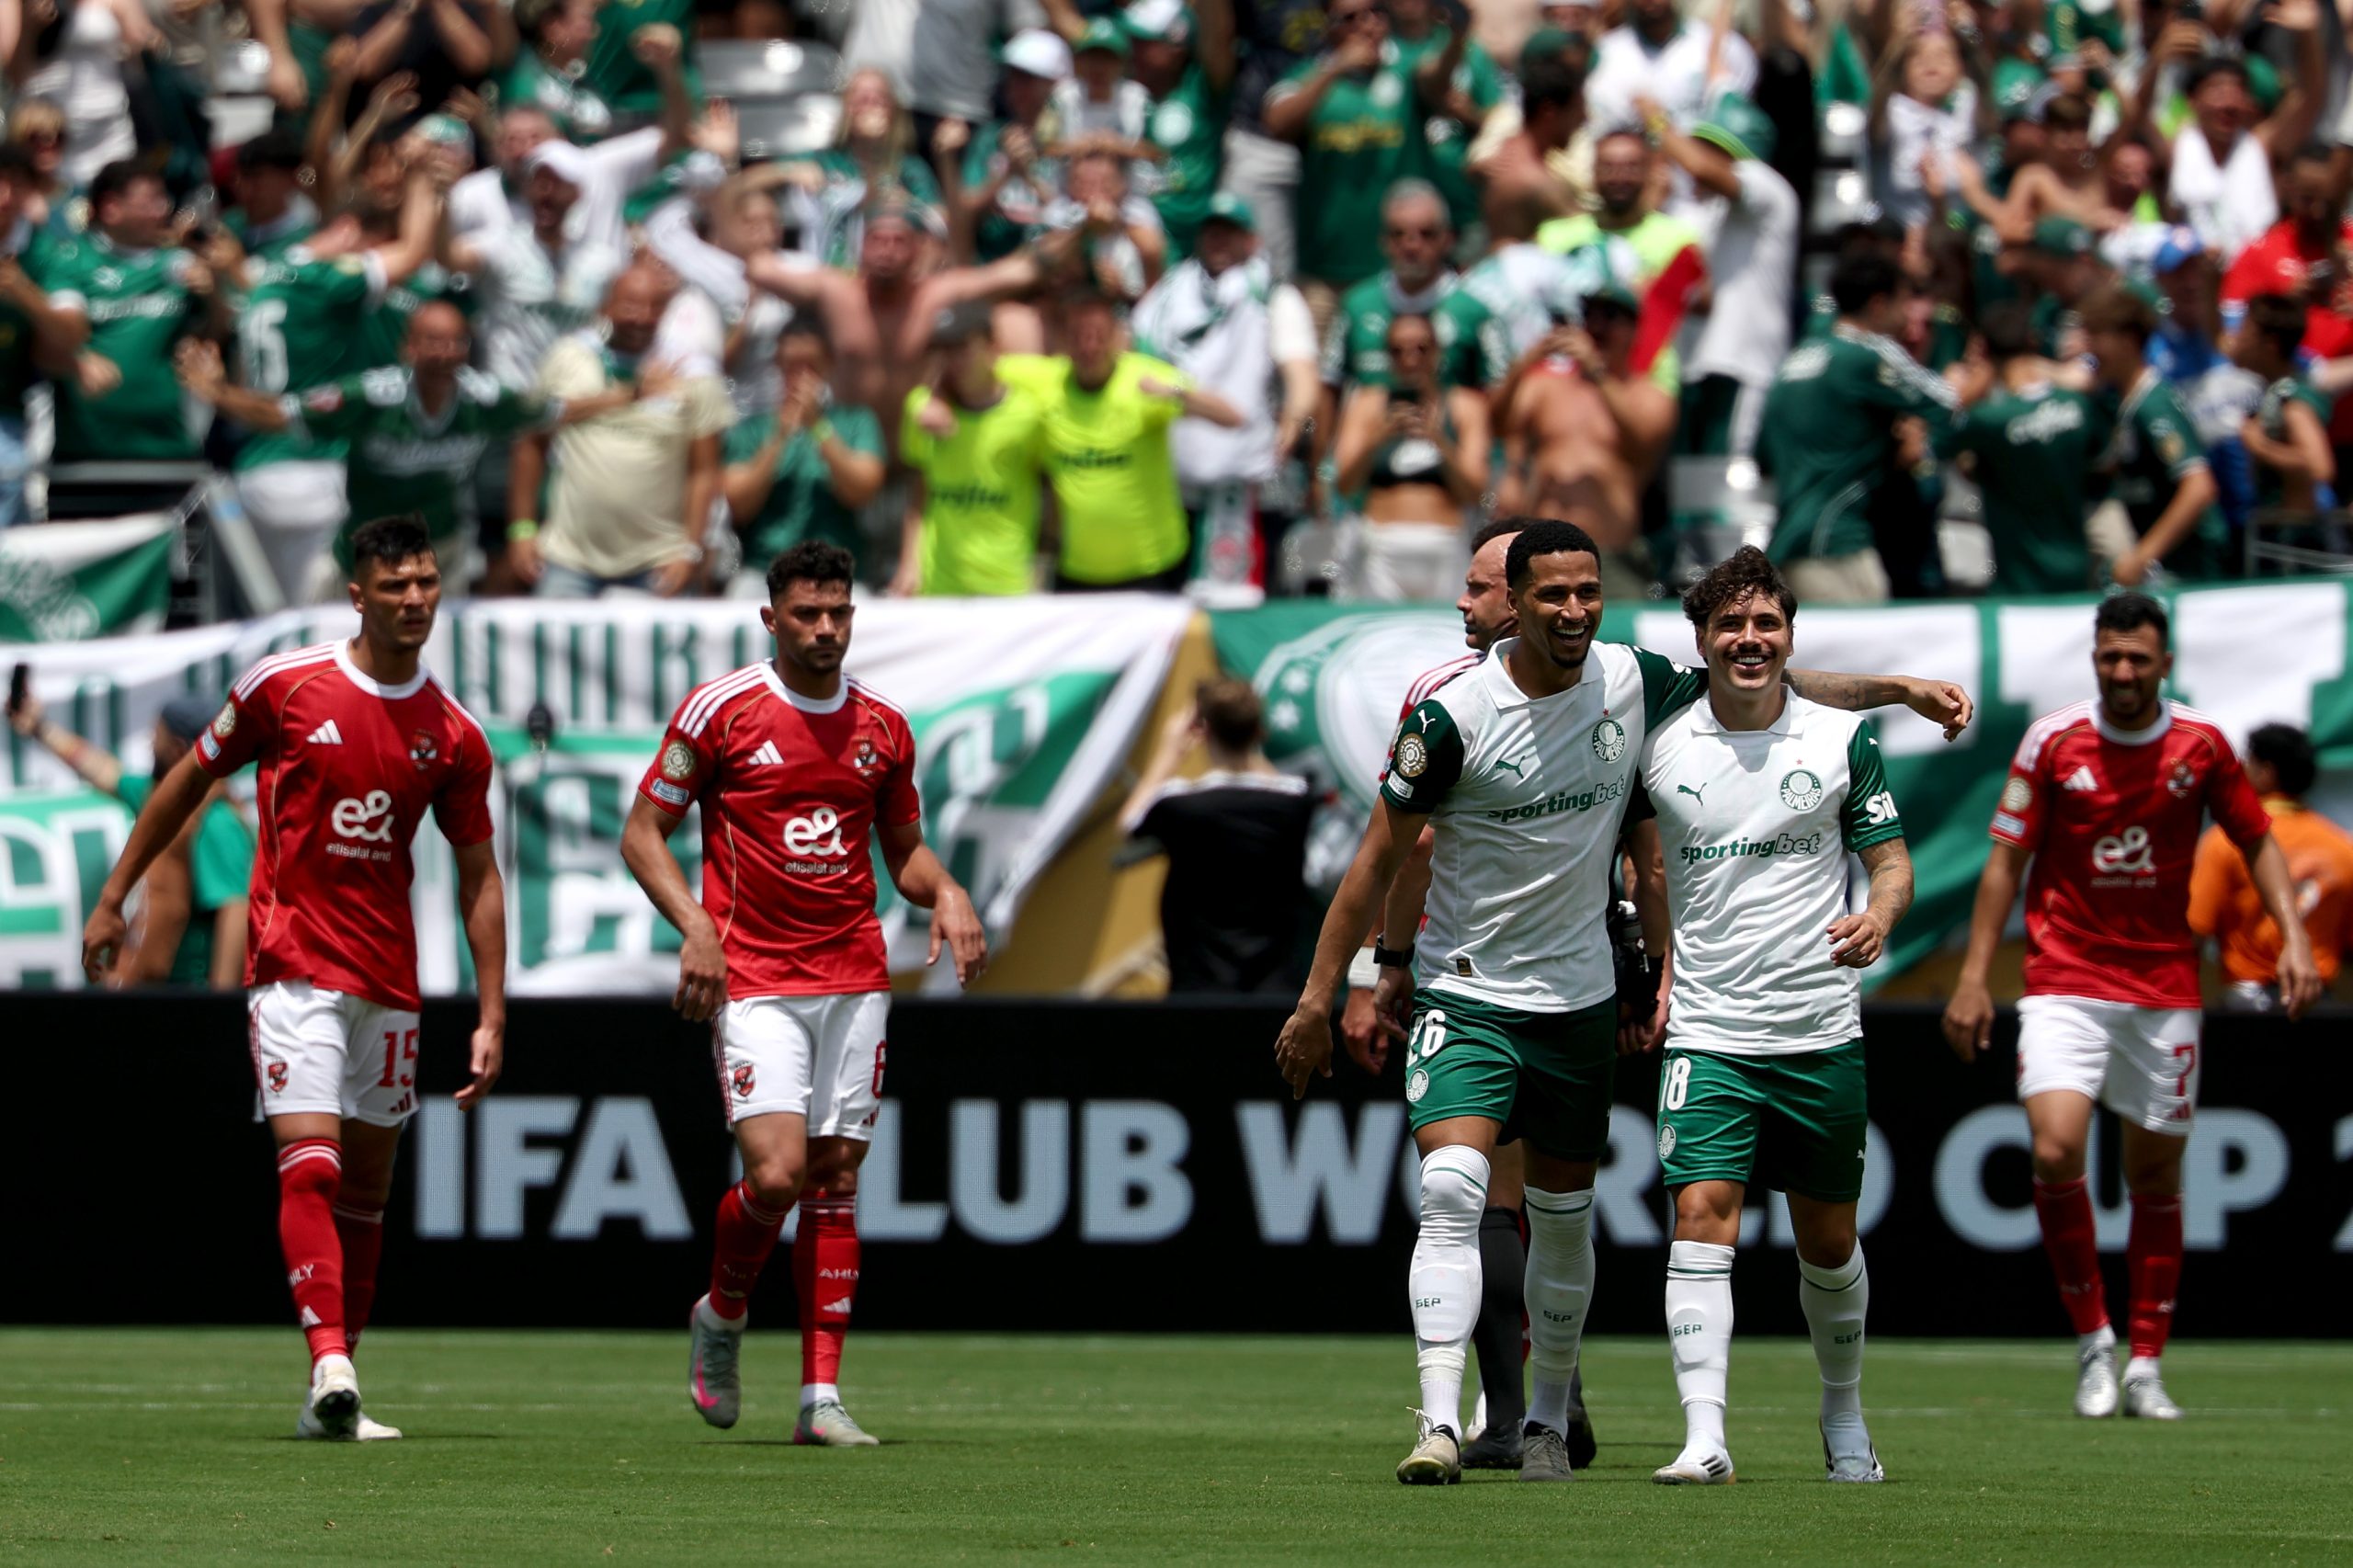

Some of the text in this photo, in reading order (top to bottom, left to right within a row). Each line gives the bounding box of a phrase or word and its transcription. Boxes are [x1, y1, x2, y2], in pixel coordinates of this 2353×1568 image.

[1593, 734, 1624, 761] PALMEIRAS
[1487, 773, 1625, 824] sportingbet
[1780, 787, 1822, 810] PALMEIRAS
[1680, 833, 1821, 864] sportingbet
[378, 1028, 420, 1088] 15
[2172, 1042, 2197, 1097] 7
[1658, 1057, 1692, 1113] 18
[412, 1096, 694, 1241] IFA
[733, 1097, 1193, 1244] LUB
[1415, 1298, 1441, 1309] SEP
[1543, 1309, 1572, 1324] SEP
[1674, 1324, 1702, 1337] SEP
[1835, 1330, 1862, 1345] SEP
